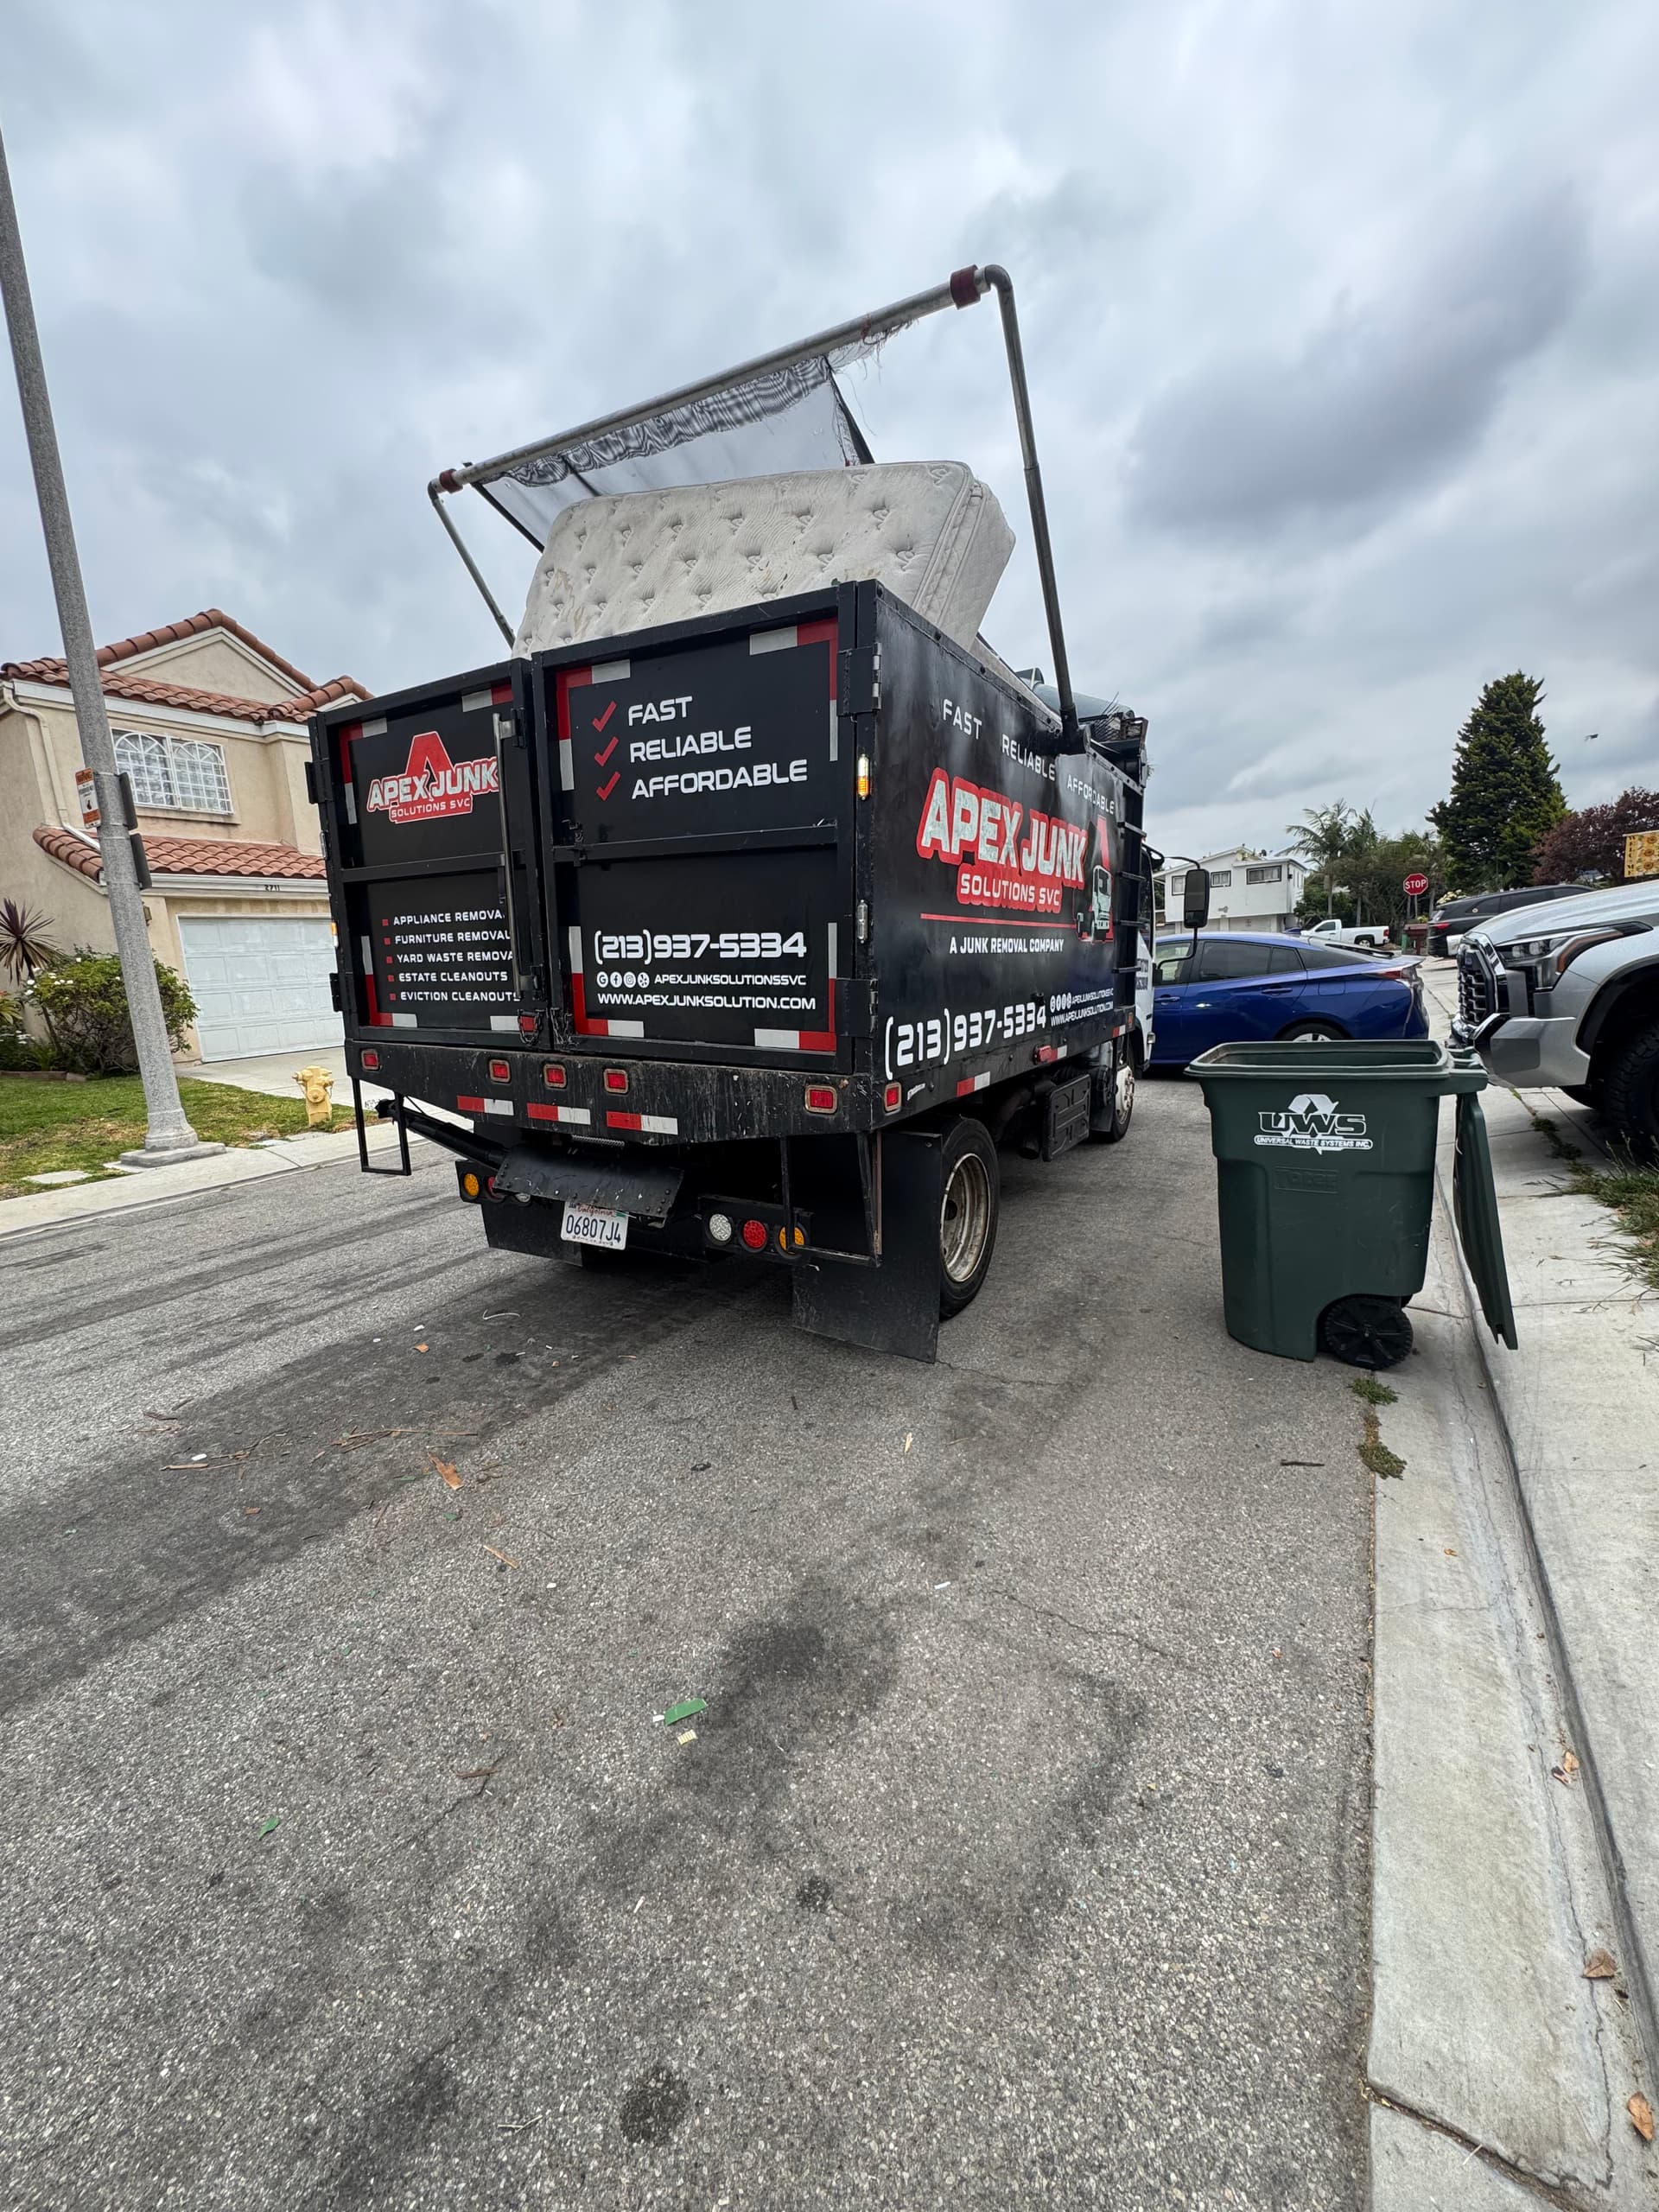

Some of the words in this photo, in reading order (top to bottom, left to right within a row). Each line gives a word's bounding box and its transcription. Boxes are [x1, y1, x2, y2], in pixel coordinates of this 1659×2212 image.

[628, 696, 693, 727] FAST
[943, 698, 982, 741] FAST
[629, 726, 753, 764] RELIABLE
[1001, 734, 1056, 782] RELIABLE
[369, 773, 428, 809] APEX
[431, 761, 499, 798] JUNK
[632, 759, 809, 800] AFFORDABLE
[391, 801, 447, 819] SOLUTIONS
[449, 798, 471, 810] SVC
[1066, 774, 1116, 816] AFFORDABLE
[920, 779, 1021, 869] APEX
[1021, 817, 1088, 883] JUNK
[960, 873, 1036, 903] SOLUTIONS
[1039, 887, 1061, 906] SVC
[1405, 879, 1427, 890] STOP
[393, 912, 452, 926] APPLIANCE
[454, 909, 505, 923] REMOVA
[395, 932, 454, 945] FURNITURE
[457, 930, 511, 940] REMOVAL
[594, 929, 808, 966] (213)937-5334
[950, 936, 957, 955] A
[959, 936, 988, 955] JUNK
[990, 938, 1028, 954] REMOVAL
[1029, 938, 1065, 952] COMPANY
[397, 953, 424, 963] YARD
[427, 952, 464, 963] WASTE
[398, 973, 438, 982] ESTATE
[440, 971, 508, 982] CLEANOUTS
[654, 974, 807, 986] APEXJUNKSOLUTIONSSVC
[400, 991, 448, 1001] EVICTION
[597, 993, 817, 1010] WWW.APEXJUNKSOLUTION.COM
[885, 1002, 1047, 1081] (213)937-5334
[1258, 1111, 1366, 1136] UWS
[1256, 1137, 1294, 1146] UNIVERSAL
[1294, 1138, 1319, 1147] WASTE
[1319, 1139, 1355, 1147] SYSTEMS
[566, 1214, 622, 1243] 06807J4
